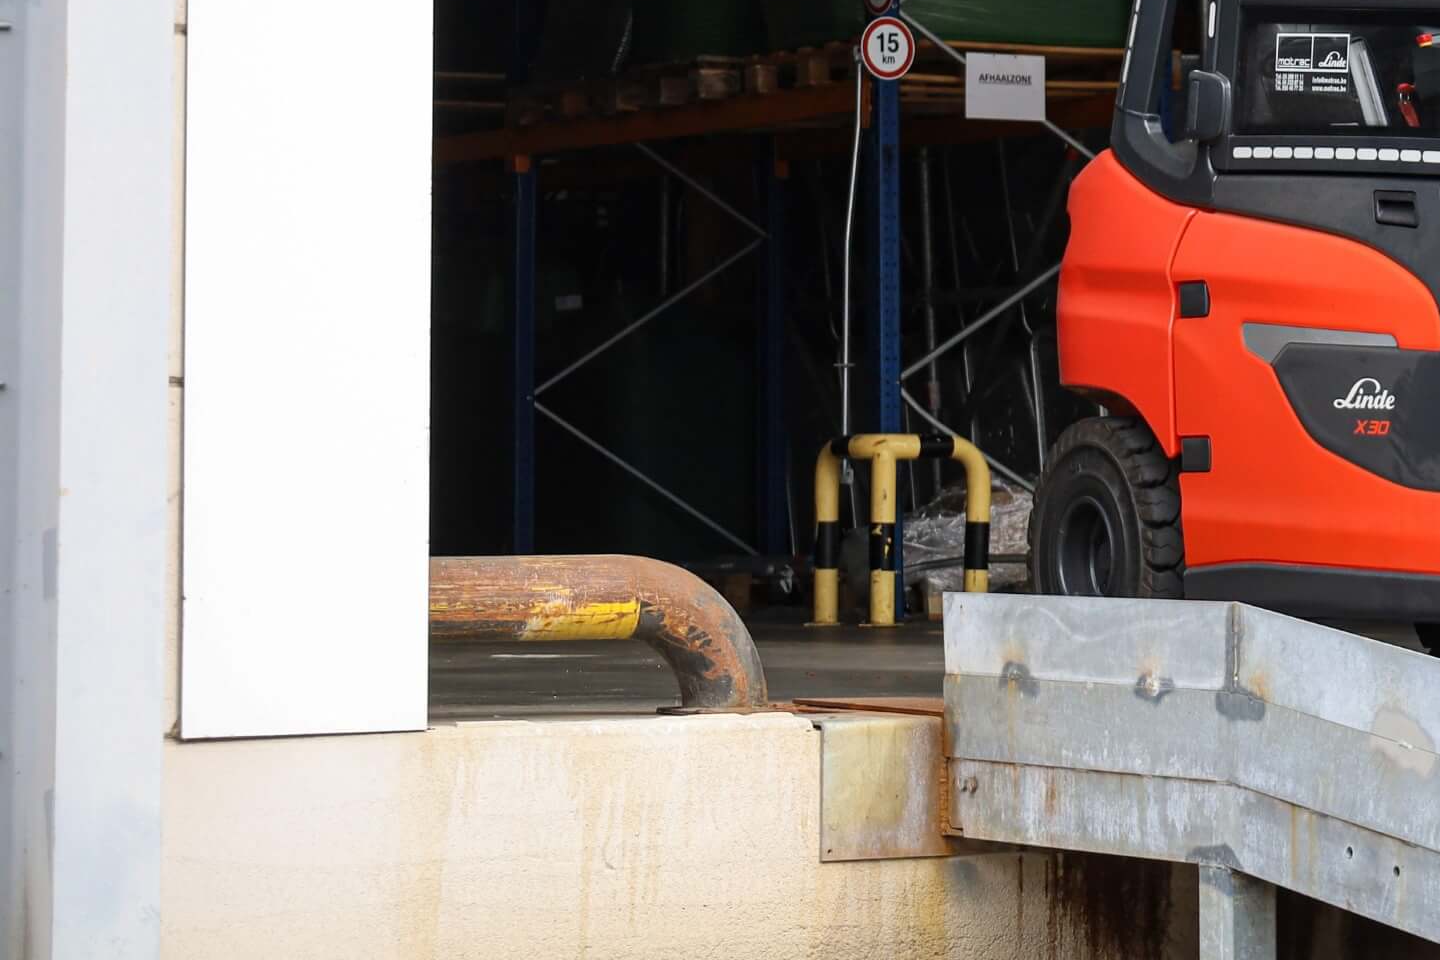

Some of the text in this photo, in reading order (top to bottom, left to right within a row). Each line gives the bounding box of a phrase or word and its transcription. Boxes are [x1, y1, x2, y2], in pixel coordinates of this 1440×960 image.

[876, 32, 899, 53] 15
[882, 54, 895, 65] km
[1278, 56, 1311, 67] motrac
[1318, 51, 1347, 68] Linde
[978, 73, 1033, 86] AFHAALZONE
[1333, 377, 1396, 410] Linde
[1353, 420, 1391, 435] X30
